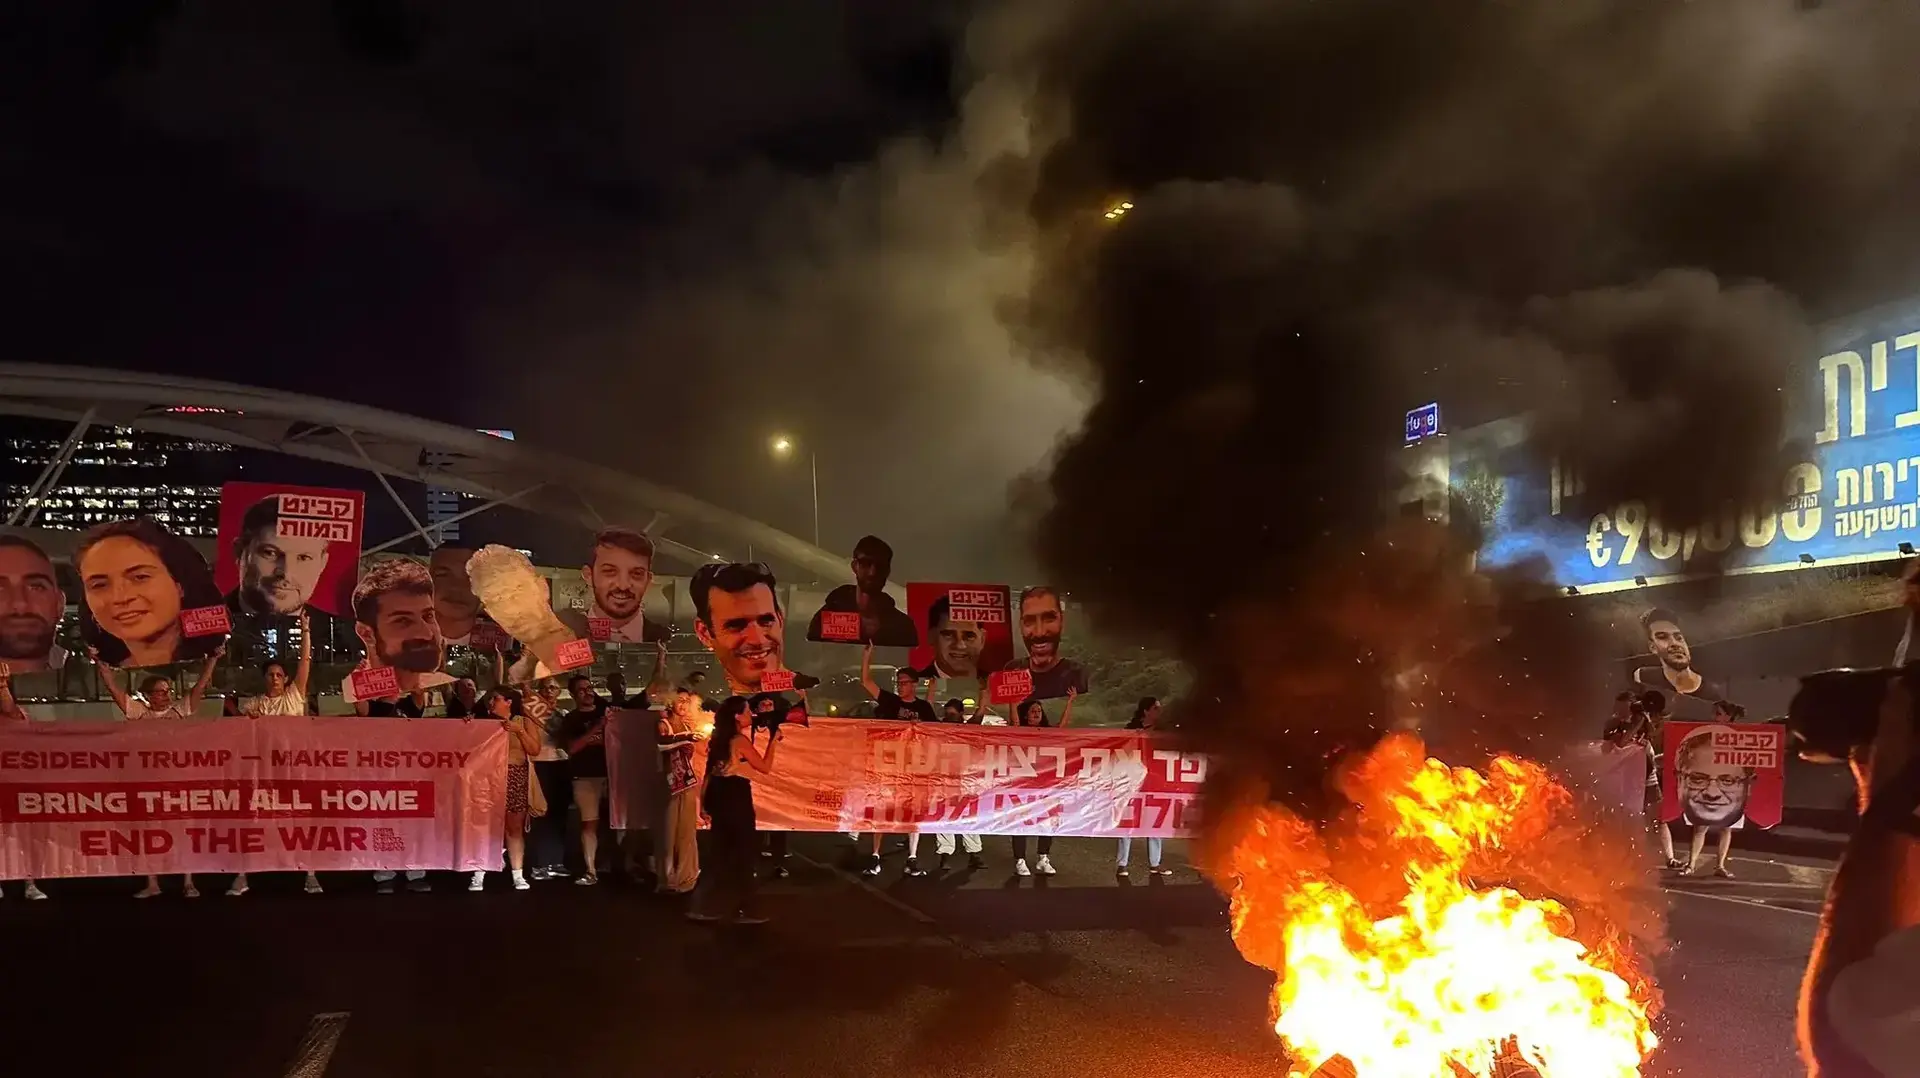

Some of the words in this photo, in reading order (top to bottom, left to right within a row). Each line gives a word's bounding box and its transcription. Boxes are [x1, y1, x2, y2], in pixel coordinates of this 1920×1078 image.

[282, 497, 350, 518] קבינט
[280, 520, 349, 540] המוות
[1834, 502, 1920, 538] השקעה
[952, 592, 1002, 606] קבינט
[952, 608, 1003, 621] המוות
[1715, 733, 1774, 748] קבינט
[1, 751, 130, 769] ESIDENT
[138, 750, 232, 769] TRUMP
[272, 750, 348, 768] MAKE
[357, 750, 471, 769] HISTORY
[874, 740, 971, 774] העם
[984, 744, 1065, 781] רצון
[1714, 752, 1773, 766] המוות
[18, 792, 128, 814] BRING
[137, 789, 240, 812] THEM
[249, 788, 312, 811] ALL
[321, 789, 418, 811] HOME
[80, 829, 173, 857] END
[186, 827, 264, 854] THE
[278, 825, 368, 852] WAR
